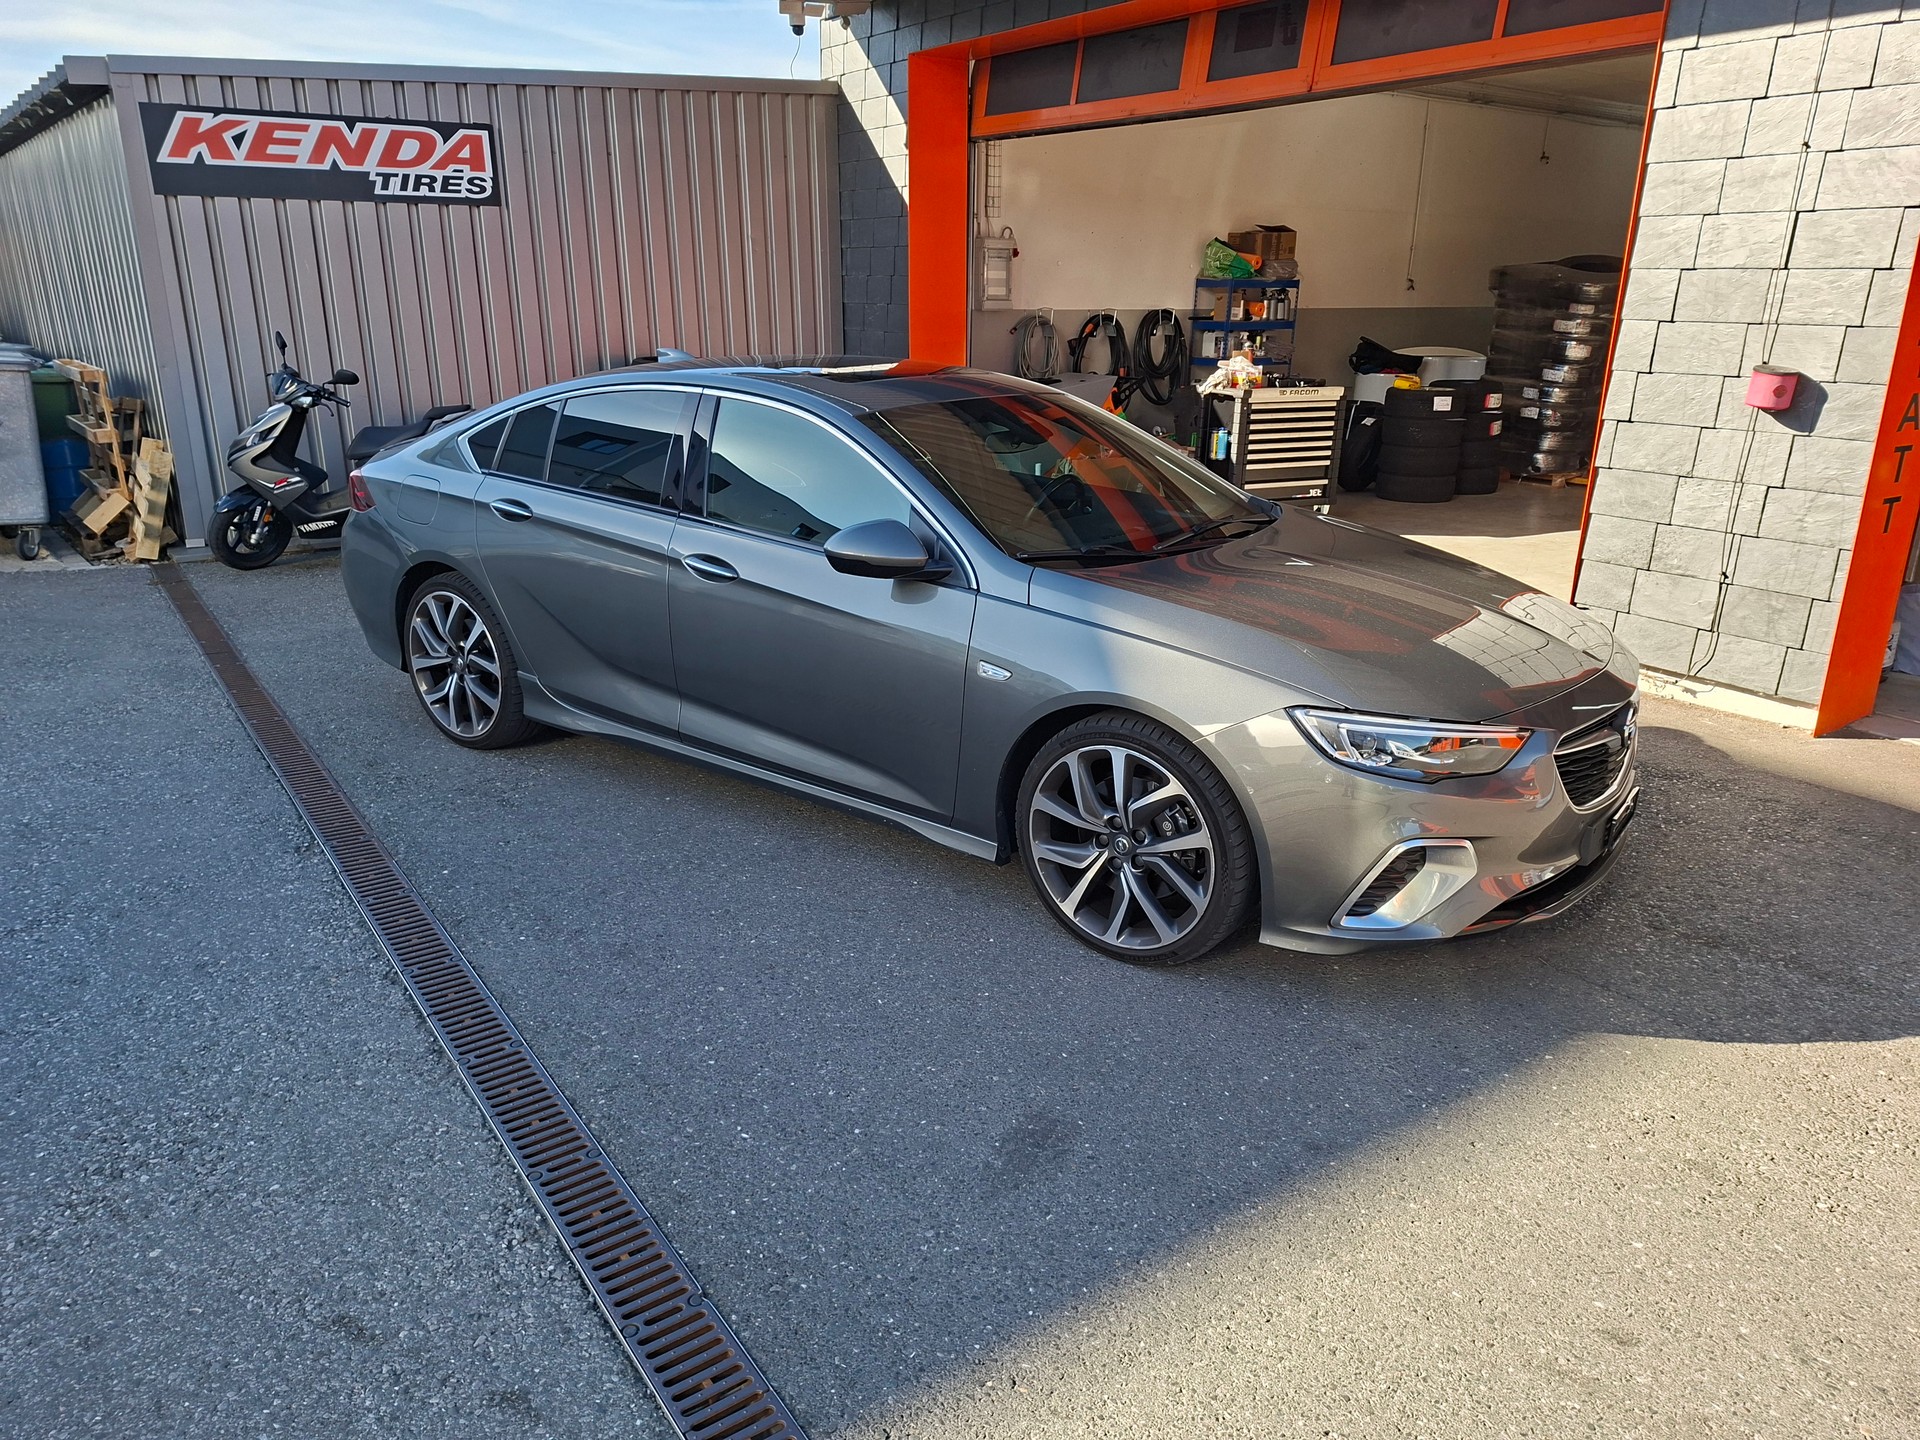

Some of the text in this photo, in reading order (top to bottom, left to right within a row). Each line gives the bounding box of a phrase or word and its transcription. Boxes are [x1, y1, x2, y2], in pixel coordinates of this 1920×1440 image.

[158, 111, 493, 176] KENDA
[371, 172, 493, 198] TIRES
[1882, 340, 1920, 534] ATT
